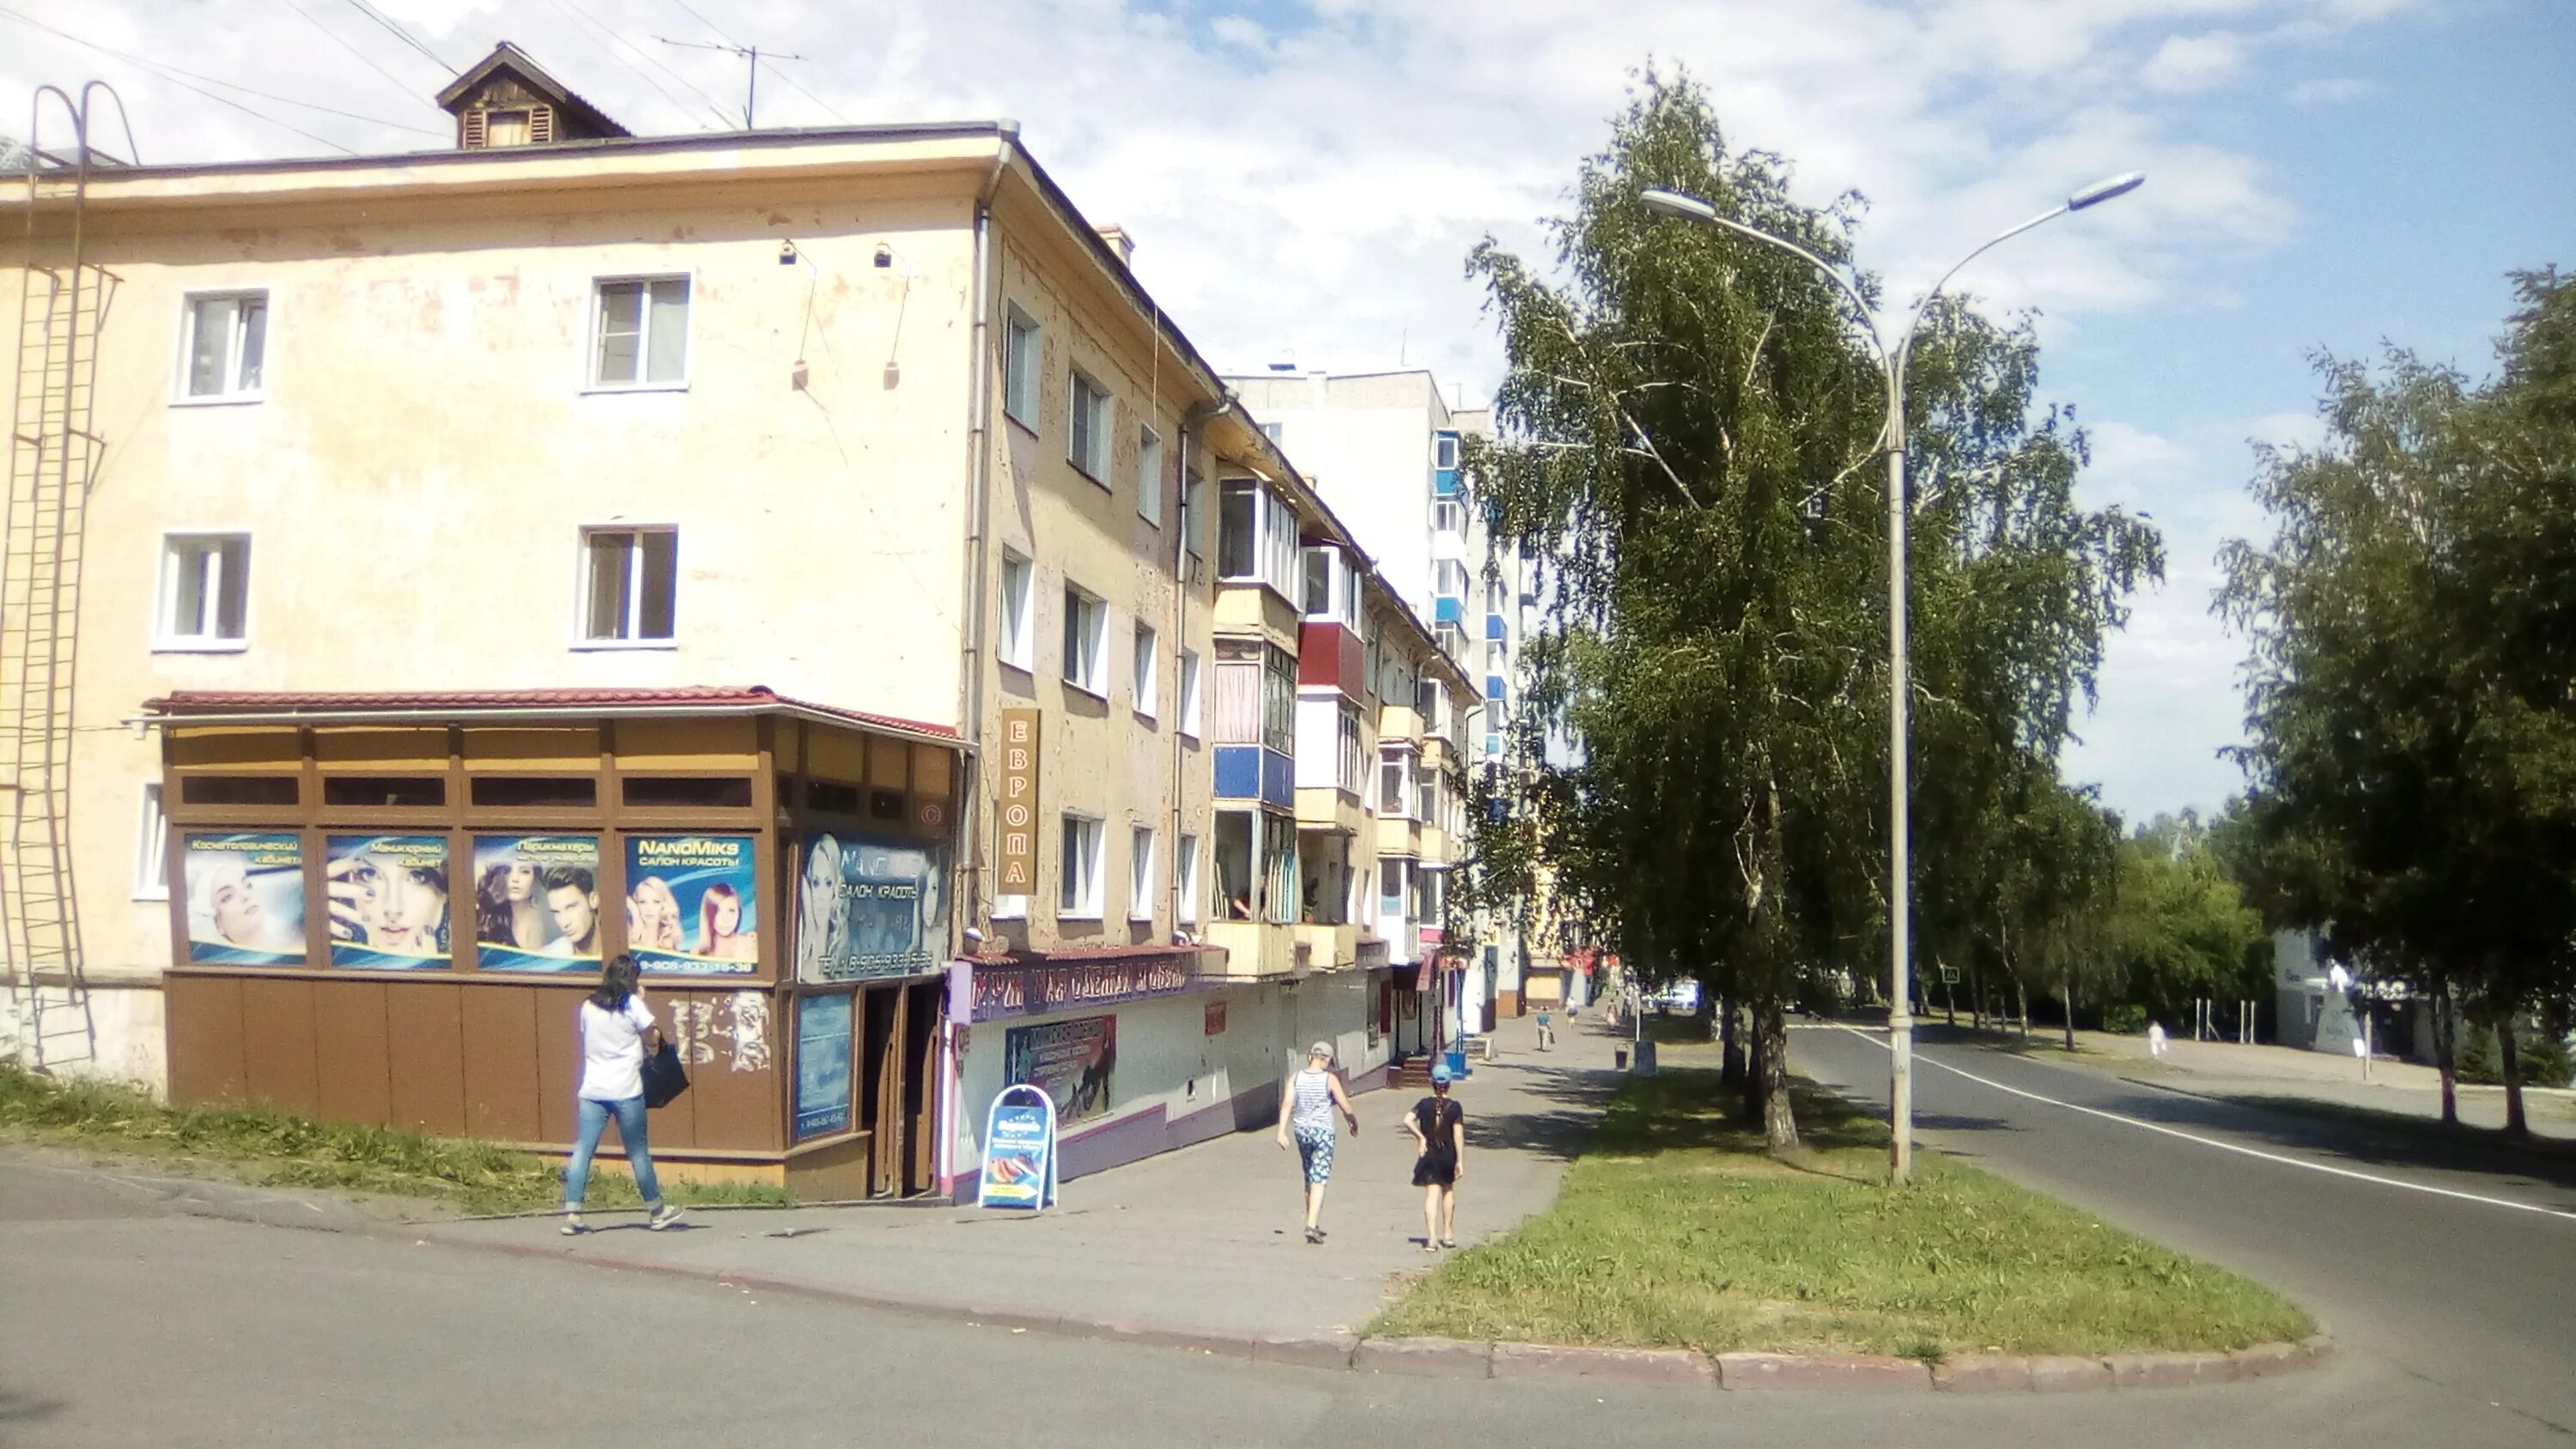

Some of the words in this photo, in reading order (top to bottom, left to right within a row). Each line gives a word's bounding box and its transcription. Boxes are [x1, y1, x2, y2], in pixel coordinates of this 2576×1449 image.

[1005, 720, 1028, 882] ЕВРОПА
[639, 857, 678, 866] САЛОН
[682, 858, 739, 867] КРАСОТЫ
